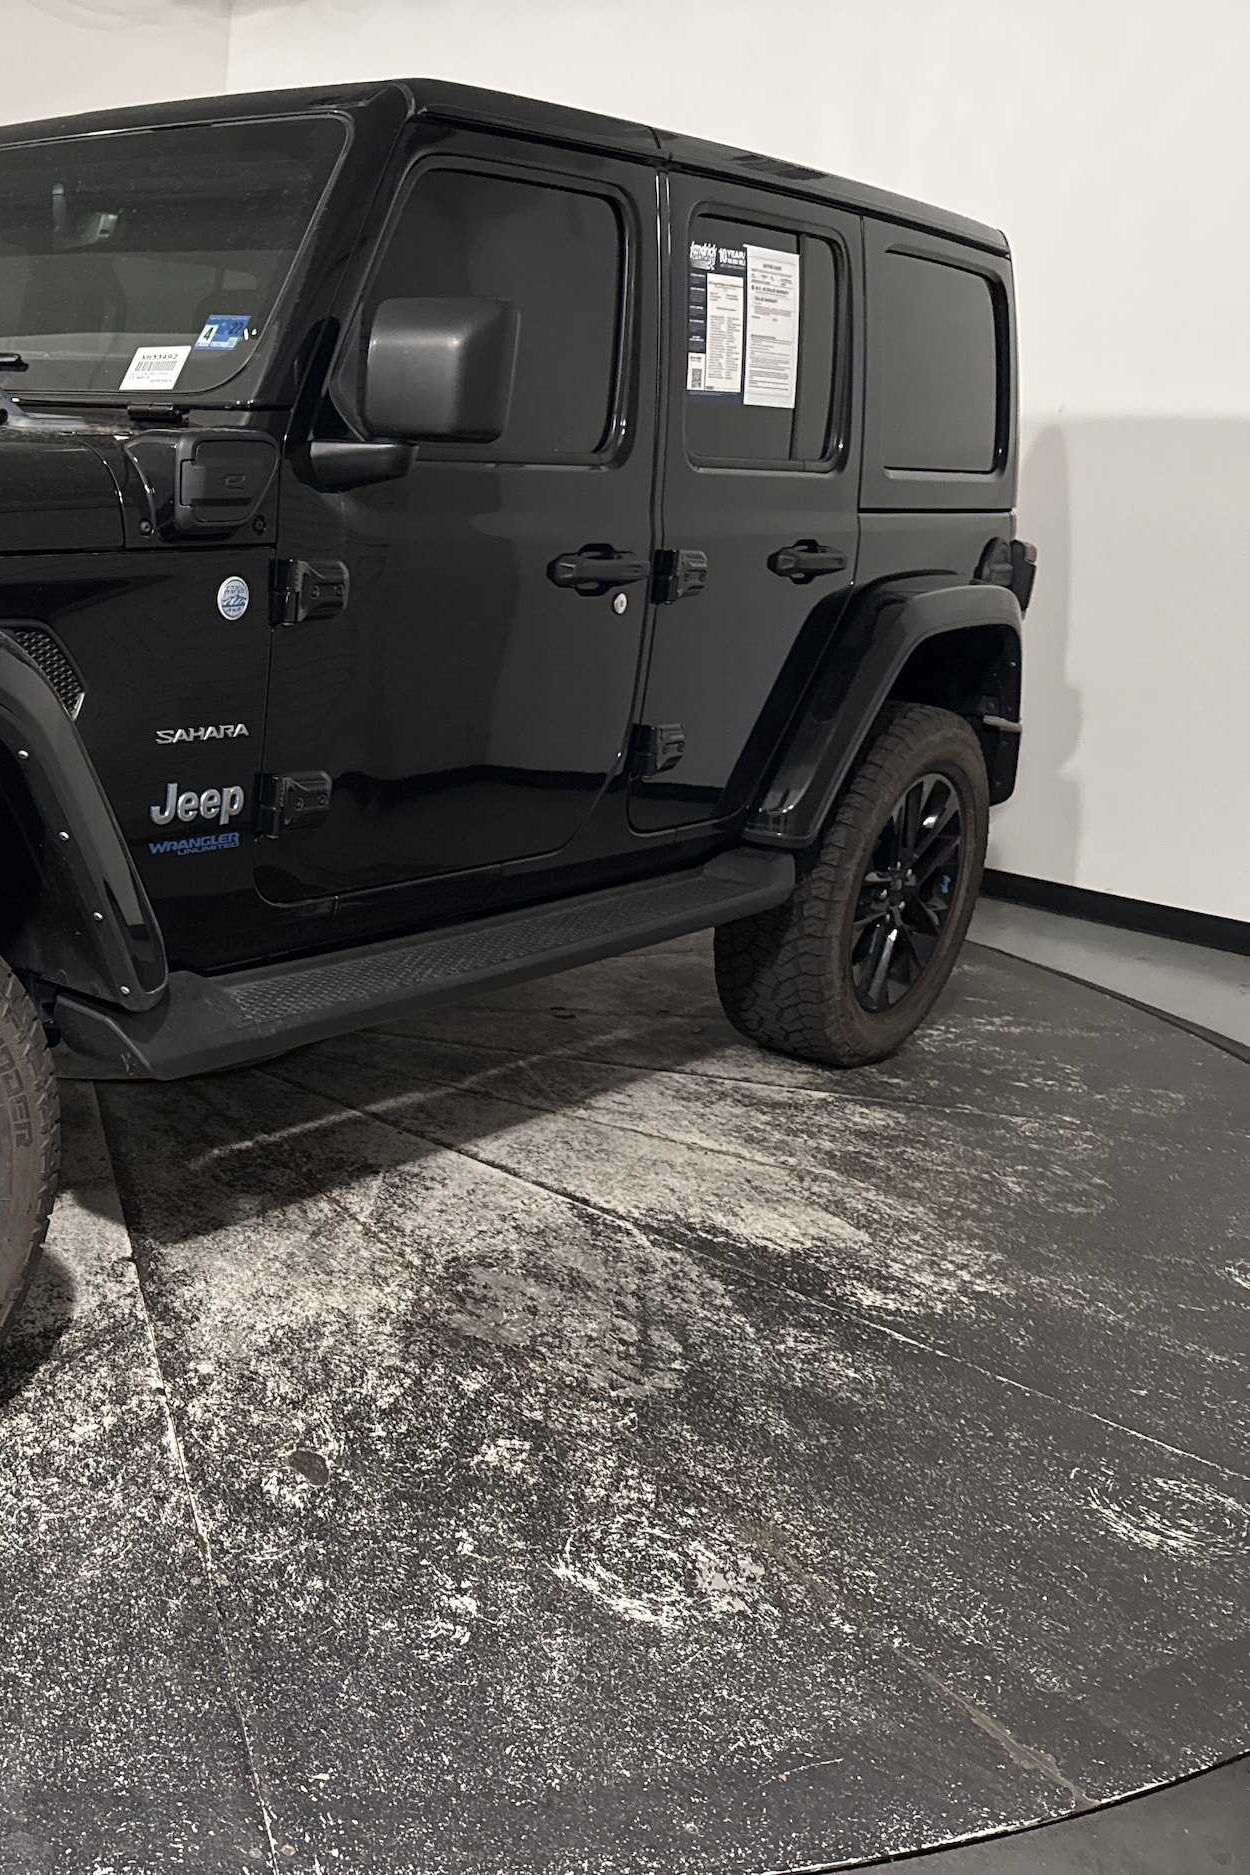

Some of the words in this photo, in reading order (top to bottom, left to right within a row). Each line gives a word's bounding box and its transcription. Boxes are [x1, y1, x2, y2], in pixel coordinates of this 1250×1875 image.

[204, 328, 214, 340] 4
[154, 722, 249, 745] SAHARA
[149, 782, 244, 826] Jeep
[148, 832, 239, 854] WRANGLER
[177, 842, 239, 856] UNLIMITED
